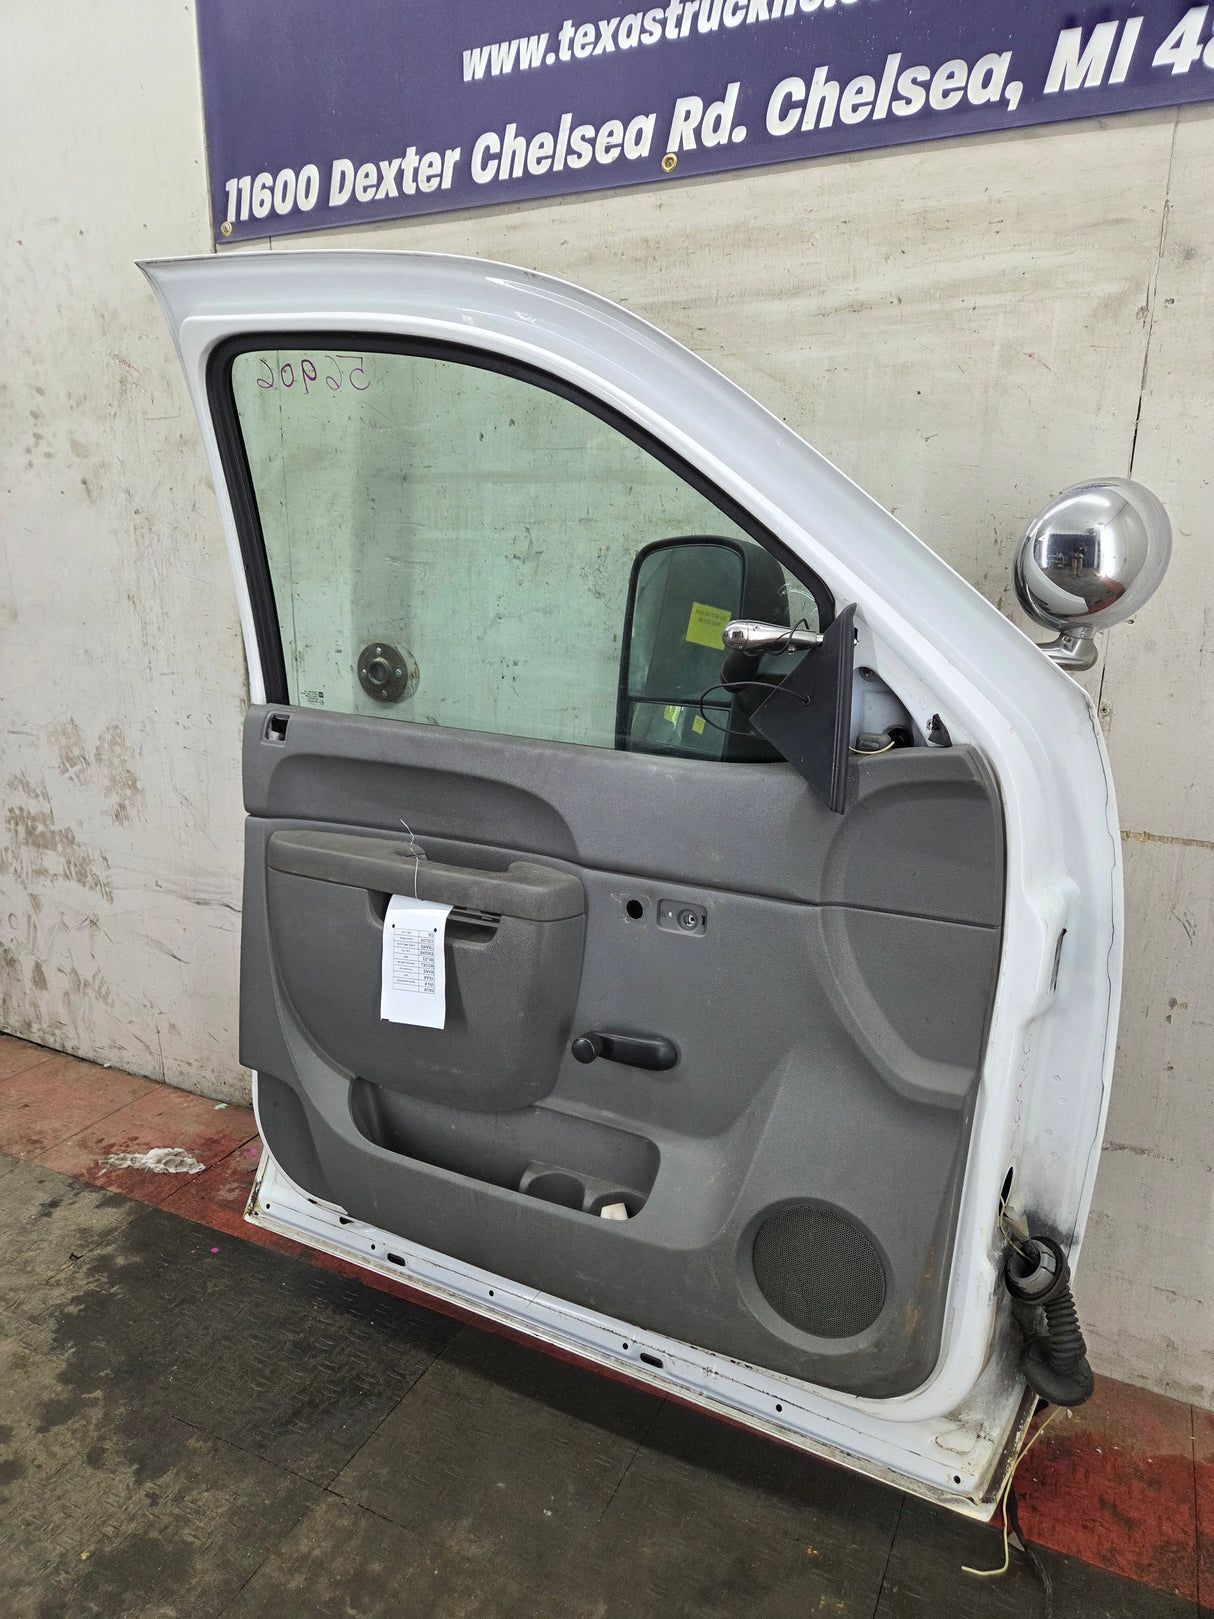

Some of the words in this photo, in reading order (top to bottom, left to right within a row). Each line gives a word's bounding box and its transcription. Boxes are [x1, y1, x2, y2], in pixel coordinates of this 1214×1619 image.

[224, 163, 320, 223] 11600
[328, 145, 461, 207] Dexter
[470, 112, 657, 184] Chelsea
[665, 81, 747, 154] Rd.
[765, 51, 1024, 137] Chelsea,
[1043, 16, 1144, 94] MI
[1151, 5, 1214, 76] 4
